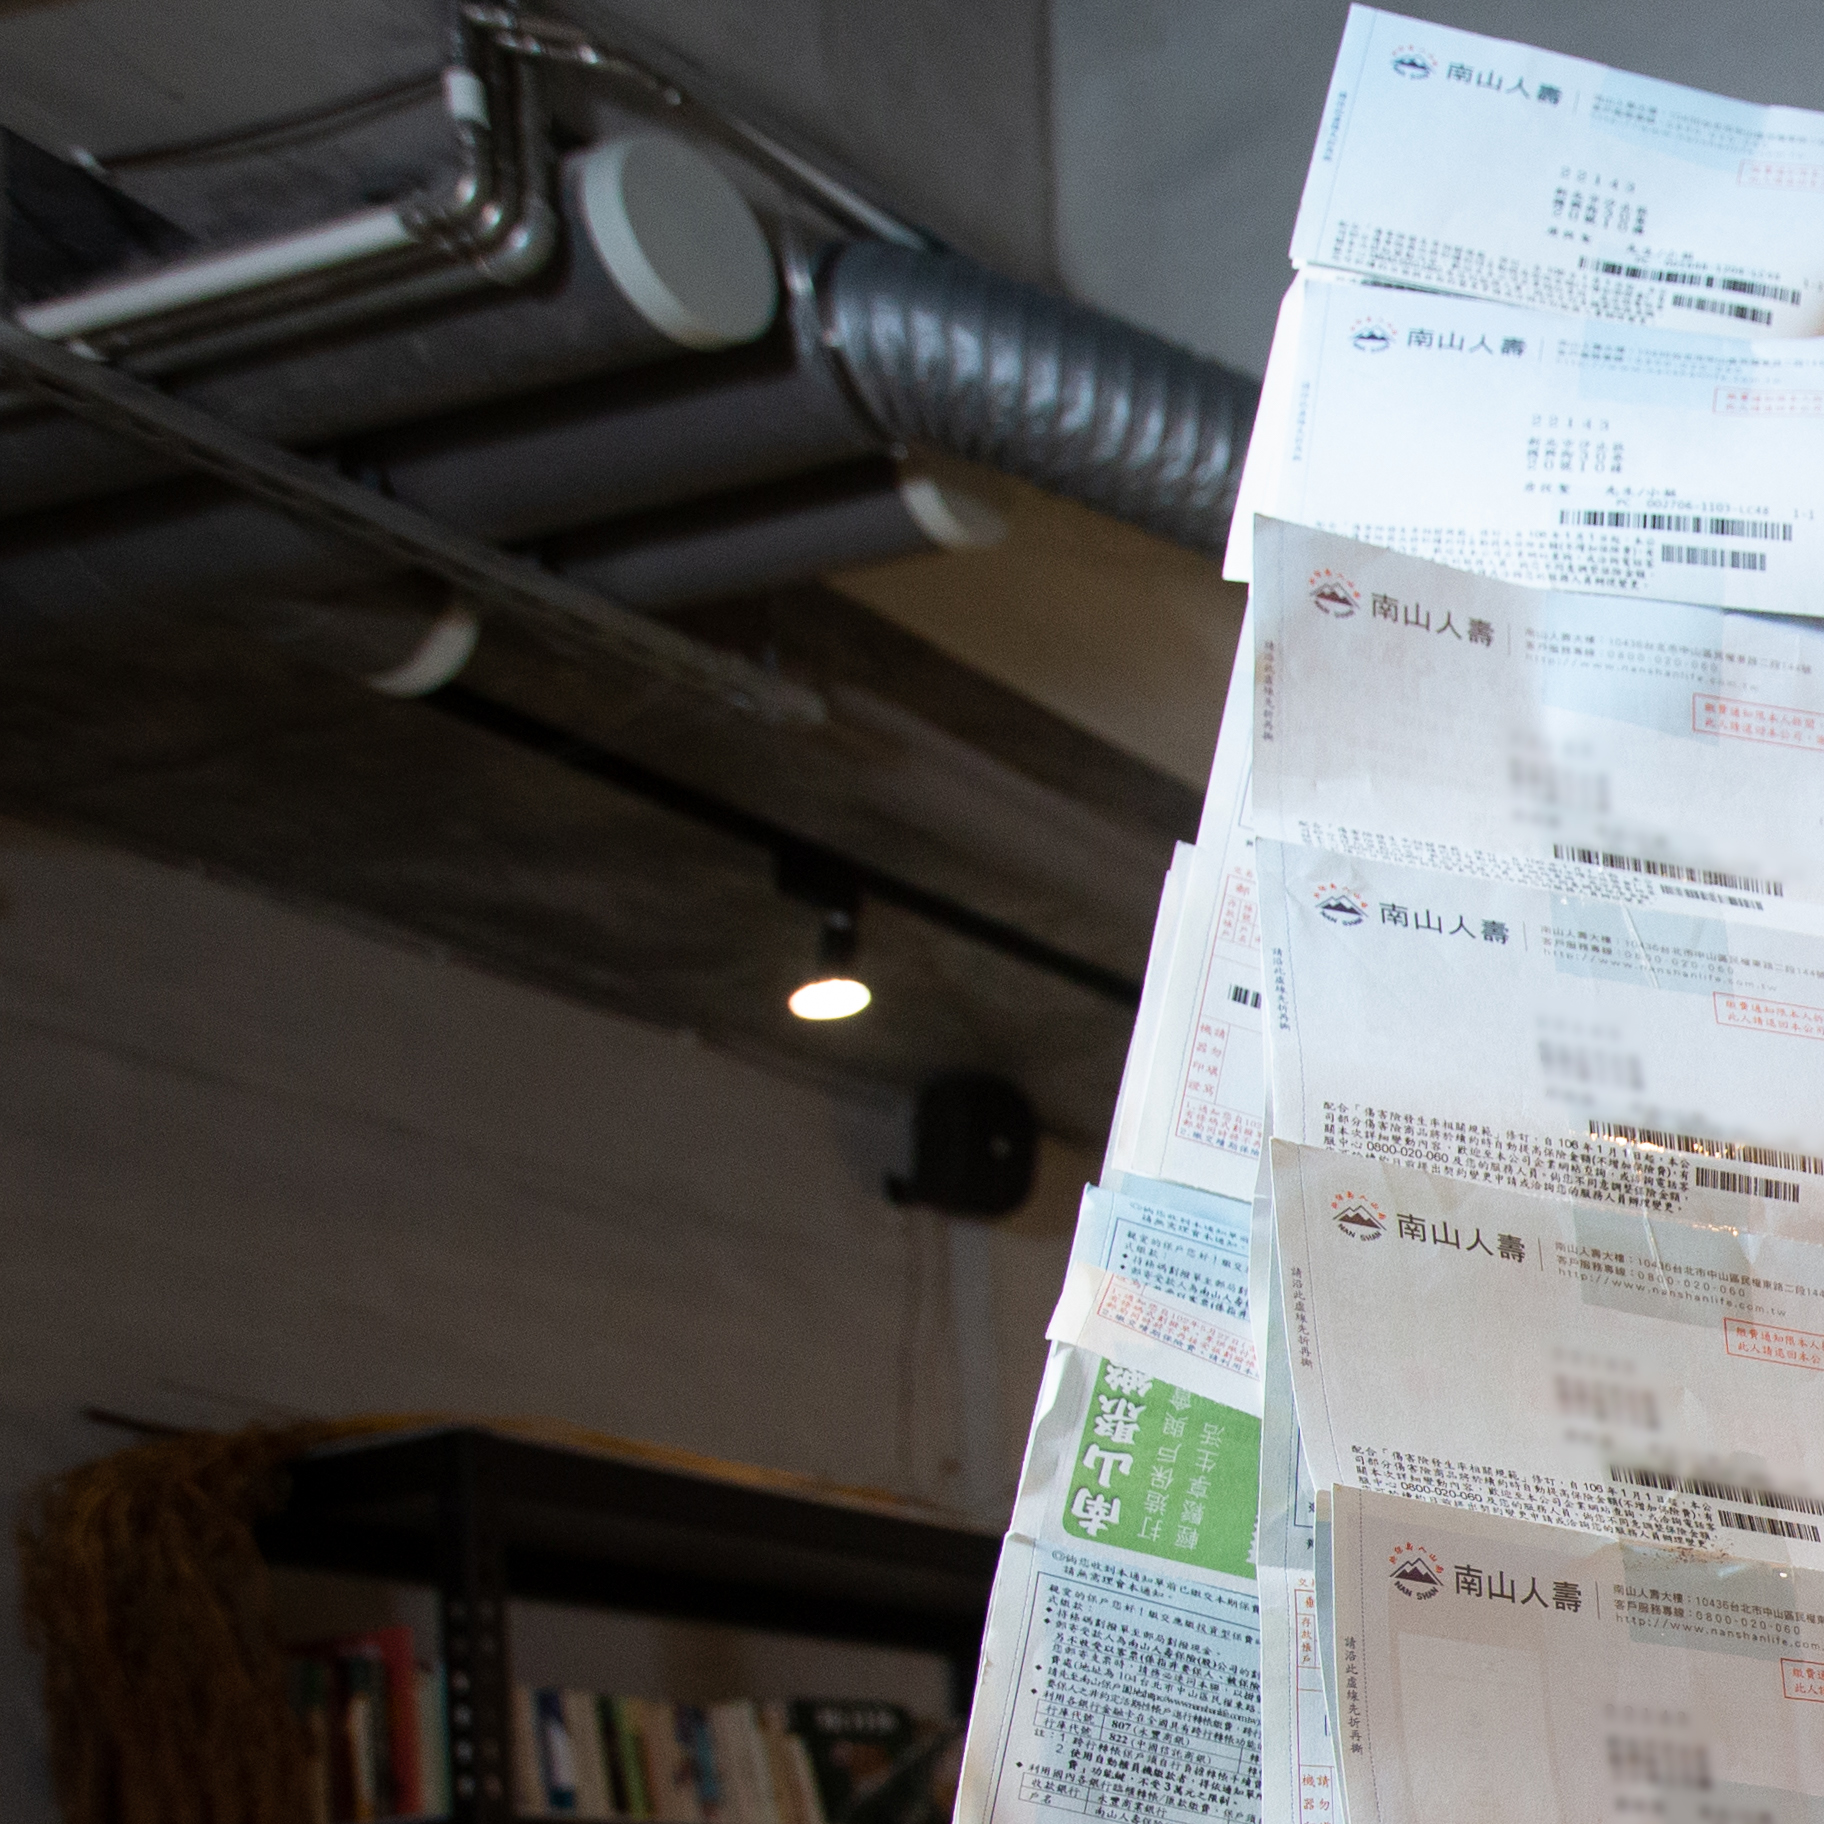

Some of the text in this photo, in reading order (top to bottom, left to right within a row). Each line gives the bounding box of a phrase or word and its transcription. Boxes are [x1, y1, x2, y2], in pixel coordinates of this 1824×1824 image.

[1406, 329, 1526, 357] 南山人壽
[1371, 592, 1494, 647] 南山人壽
[1379, 901, 1509, 945] 南山人壽
[1367, 1141, 1449, 1163] 0800-020-060
[1559, 1138, 1578, 1149] 106
[1396, 1213, 1525, 1264] 南山人壽
[1401, 1482, 1482, 1502] 0800-020-060
[1584, 1482, 1603, 1492] 106
[1394, 1580, 1440, 1601] NAN SHAN
[1454, 1565, 1582, 1613] 南山人壽
[1111, 1720, 1132, 1731] 807
[1109, 1732, 1128, 1745] 822
